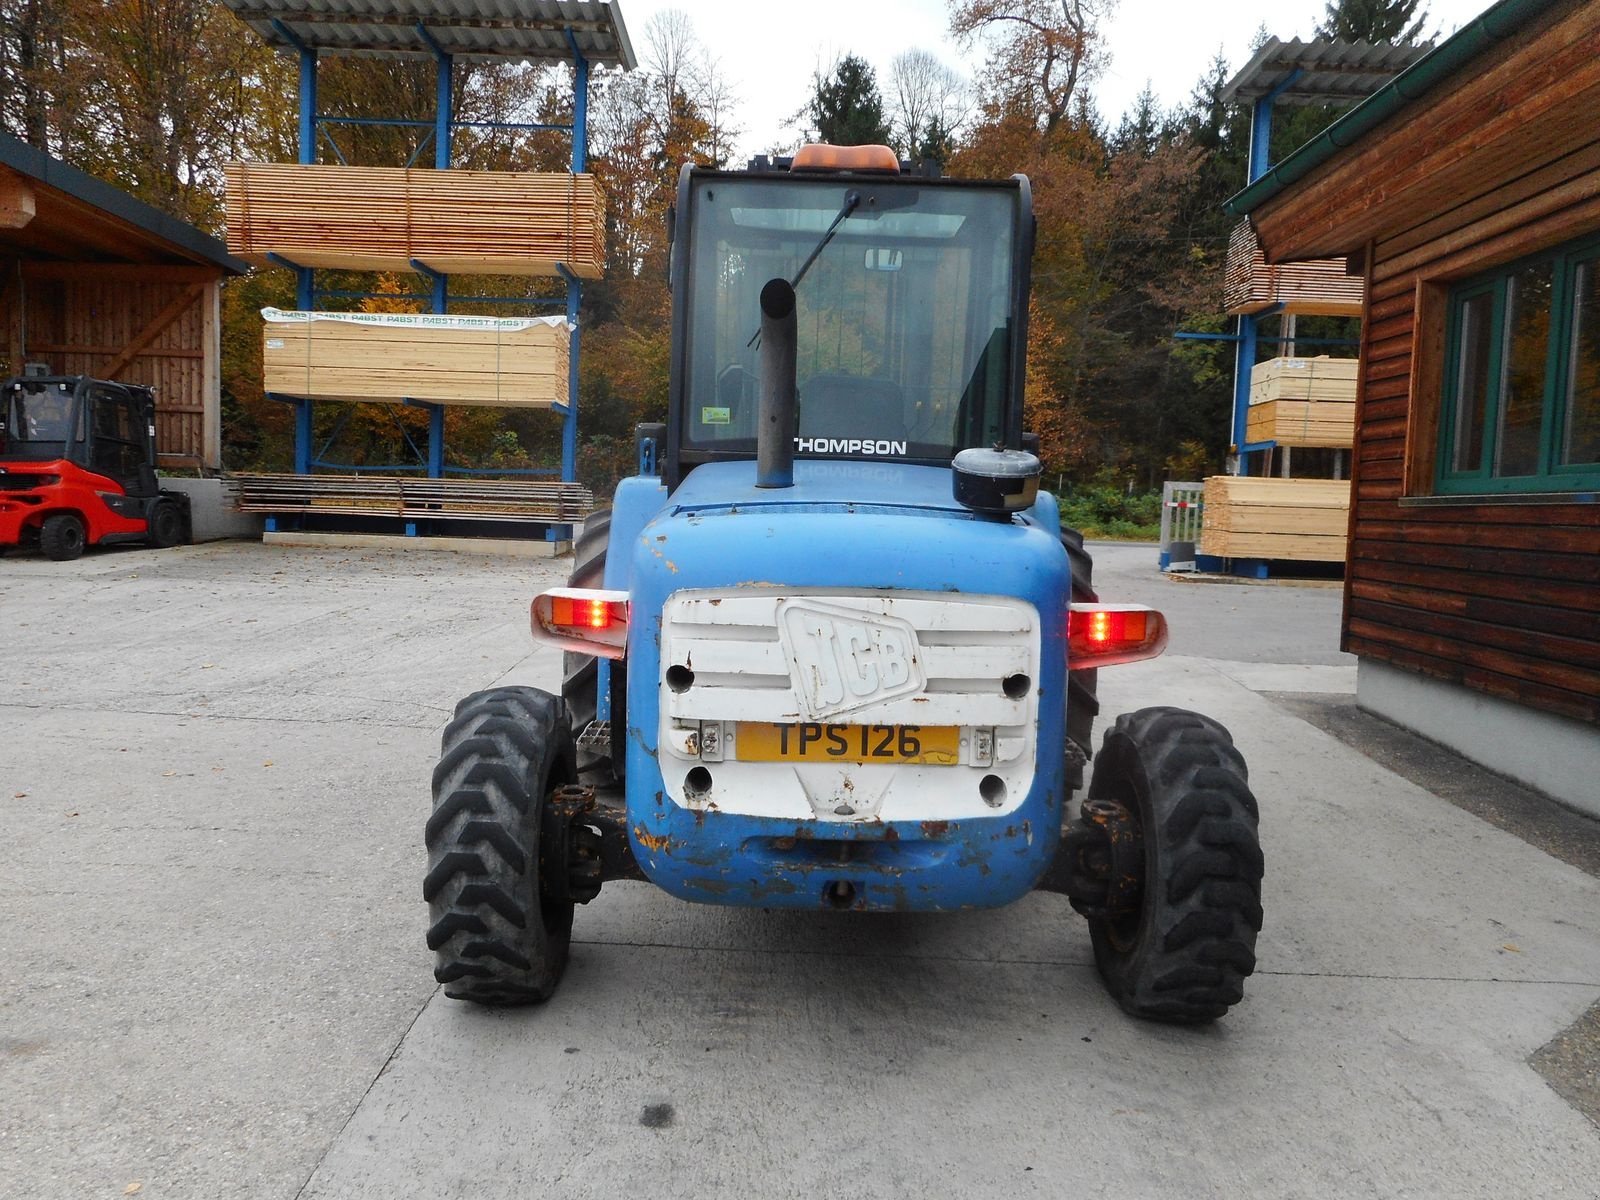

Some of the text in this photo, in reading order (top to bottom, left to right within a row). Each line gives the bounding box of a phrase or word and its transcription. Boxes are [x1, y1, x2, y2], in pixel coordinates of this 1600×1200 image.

[351, 314, 384, 322] PABST
[386, 315, 419, 323] PABST
[422, 317, 455, 325] PABST
[493, 319, 525, 327] PABST
[803, 611, 910, 711] JCB
[773, 722, 921, 757] TPS 126
